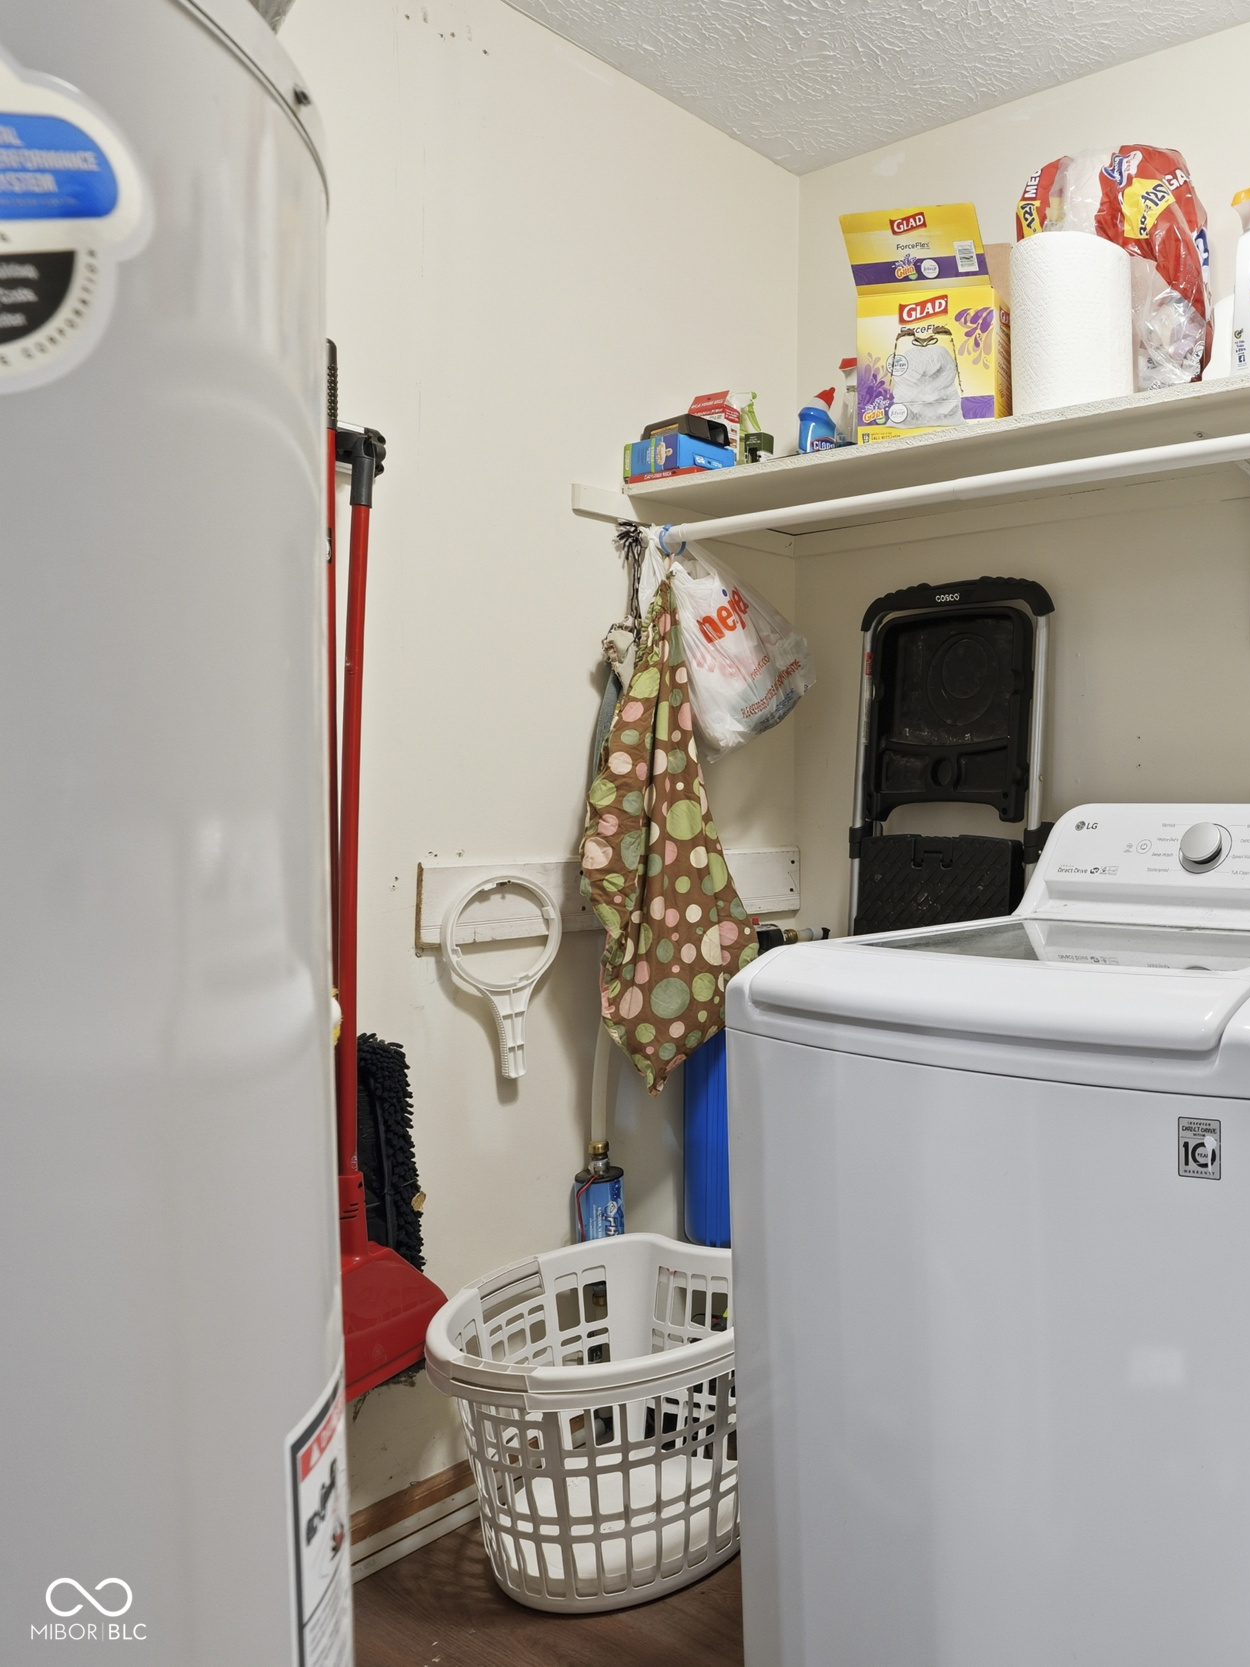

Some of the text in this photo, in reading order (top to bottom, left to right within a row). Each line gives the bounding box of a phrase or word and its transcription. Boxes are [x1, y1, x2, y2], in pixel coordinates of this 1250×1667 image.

[893, 214, 925, 233] GLAD
[896, 242, 930, 251] ForceFlex
[902, 298, 944, 322] GLAD
[935, 592, 959, 603] COSCO
[1086, 822, 1098, 830] LG
[1182, 1125, 1217, 1135] DIRECT DRIVE
[1182, 1140, 1217, 1169] 10
